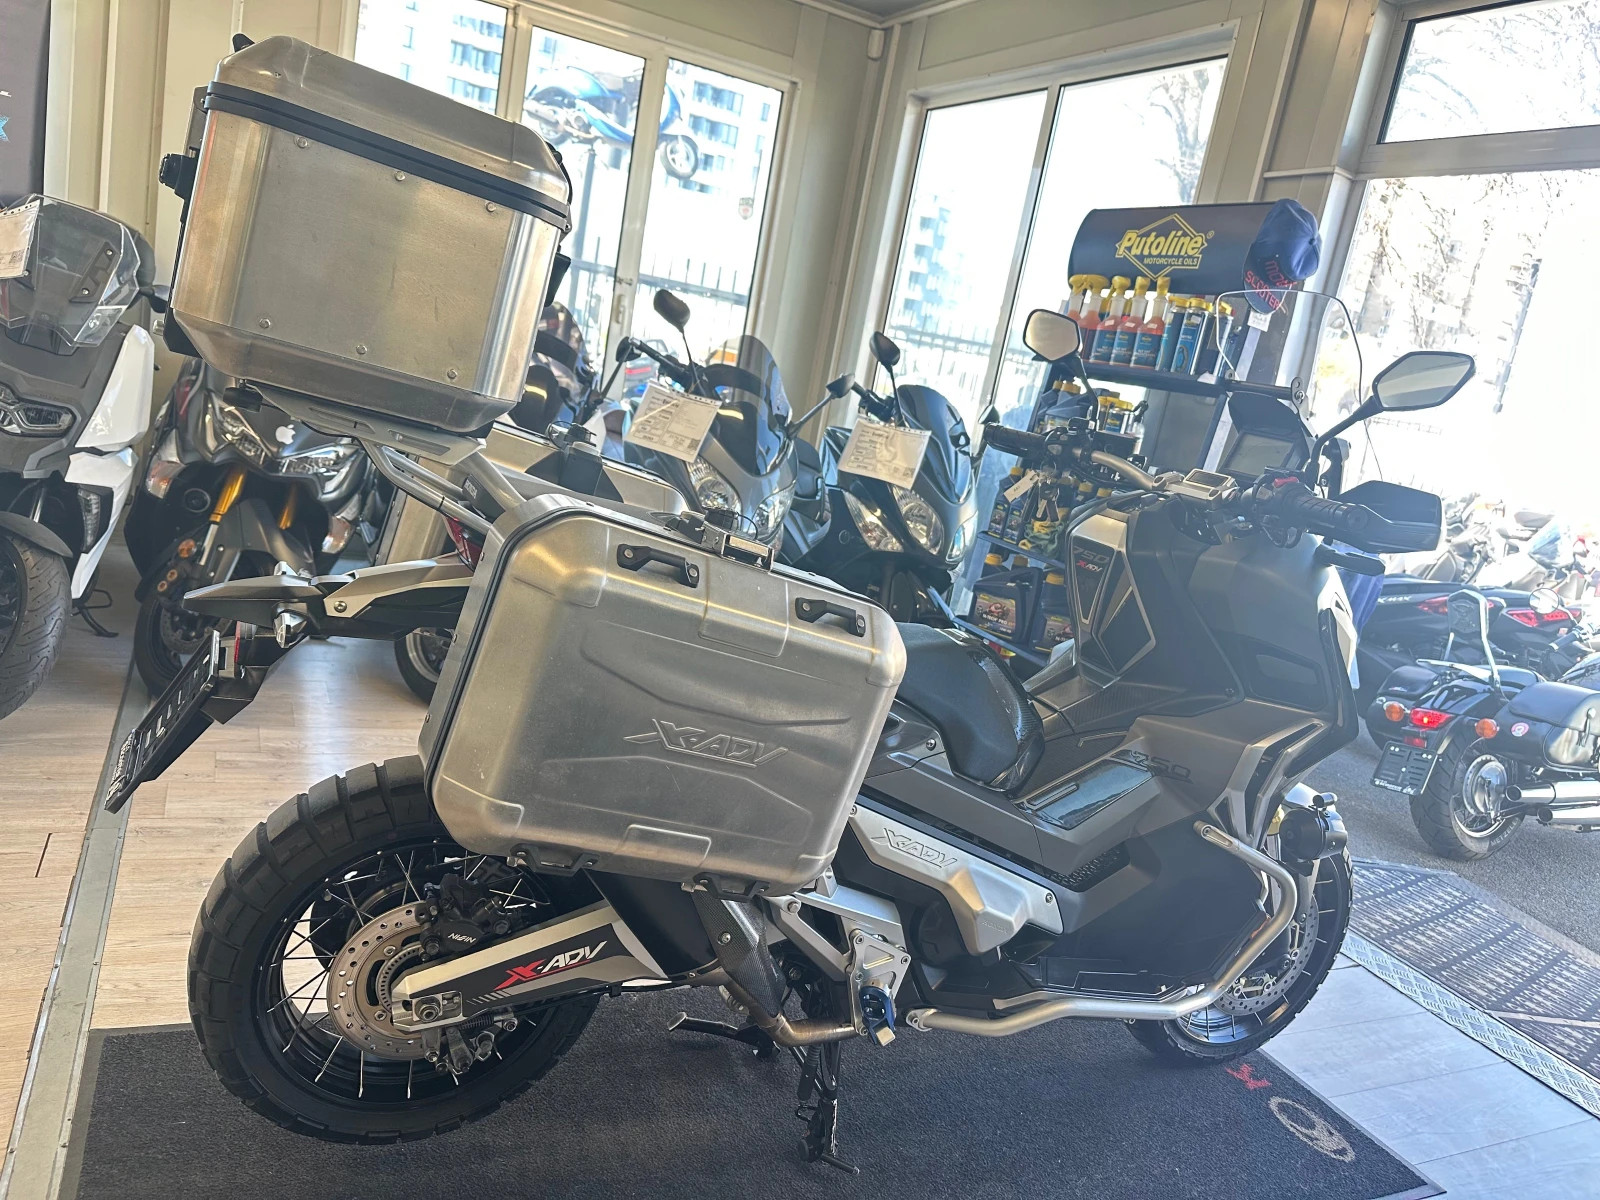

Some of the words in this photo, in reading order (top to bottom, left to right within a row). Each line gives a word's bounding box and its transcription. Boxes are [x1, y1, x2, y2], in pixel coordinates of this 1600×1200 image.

[1119, 231, 1203, 256] Putoline
[1144, 257, 1182, 265] MOTORCYCLE
[1183, 258, 1197, 266] OILS
[1245, 270, 1281, 310] SCOOTER
[623, 718, 789, 768] X-ADV
[870, 827, 958, 868] X-ADV
[493, 940, 608, 991] X-ADV
